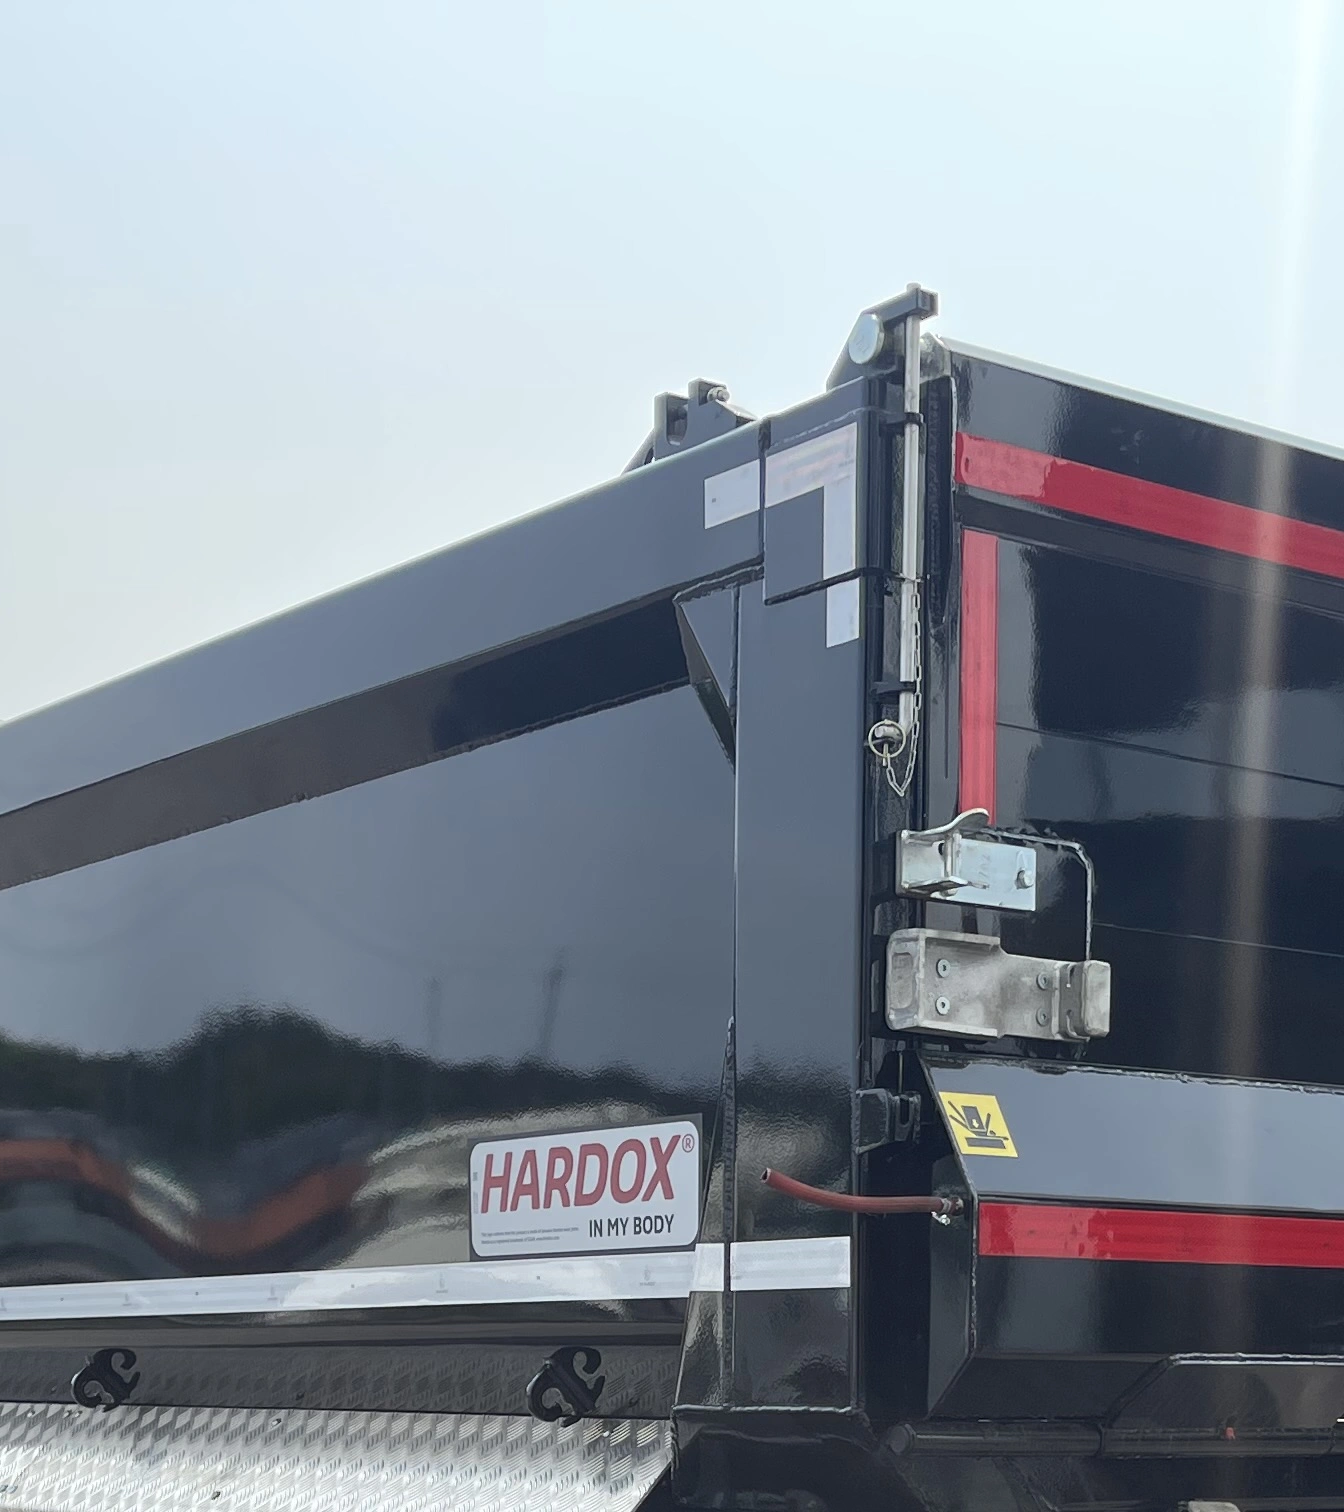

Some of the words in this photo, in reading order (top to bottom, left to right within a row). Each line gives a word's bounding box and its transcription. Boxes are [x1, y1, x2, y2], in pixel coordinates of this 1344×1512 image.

[589, 1218, 603, 1238] IN
[607, 1216, 629, 1237] MY
[633, 1213, 675, 1235] BODY
